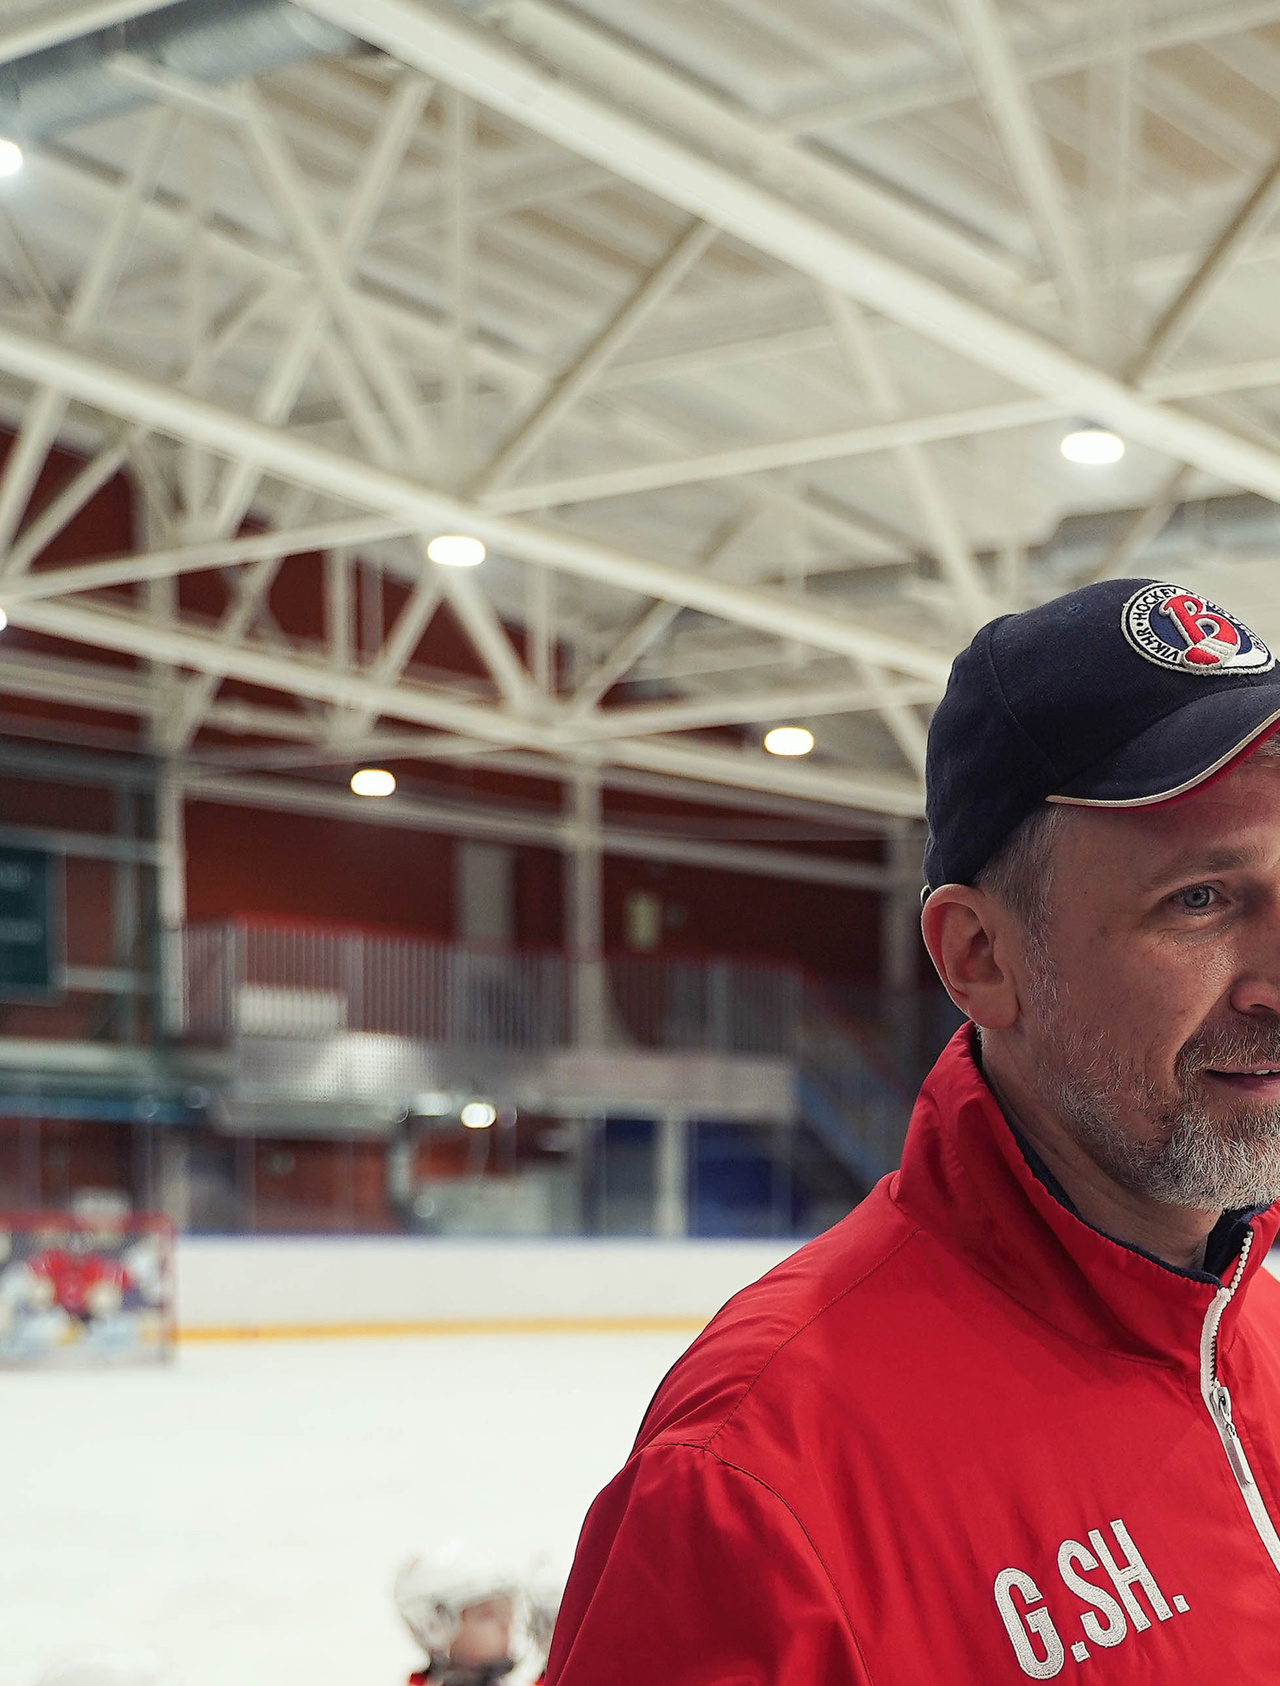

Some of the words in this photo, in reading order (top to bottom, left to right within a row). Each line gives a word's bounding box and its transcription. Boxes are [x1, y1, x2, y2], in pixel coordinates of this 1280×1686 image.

[1132, 587, 1177, 621] HOCKEY
[1136, 627, 1179, 662] VIKHR
[993, 1518, 1191, 1680] G.SH.
